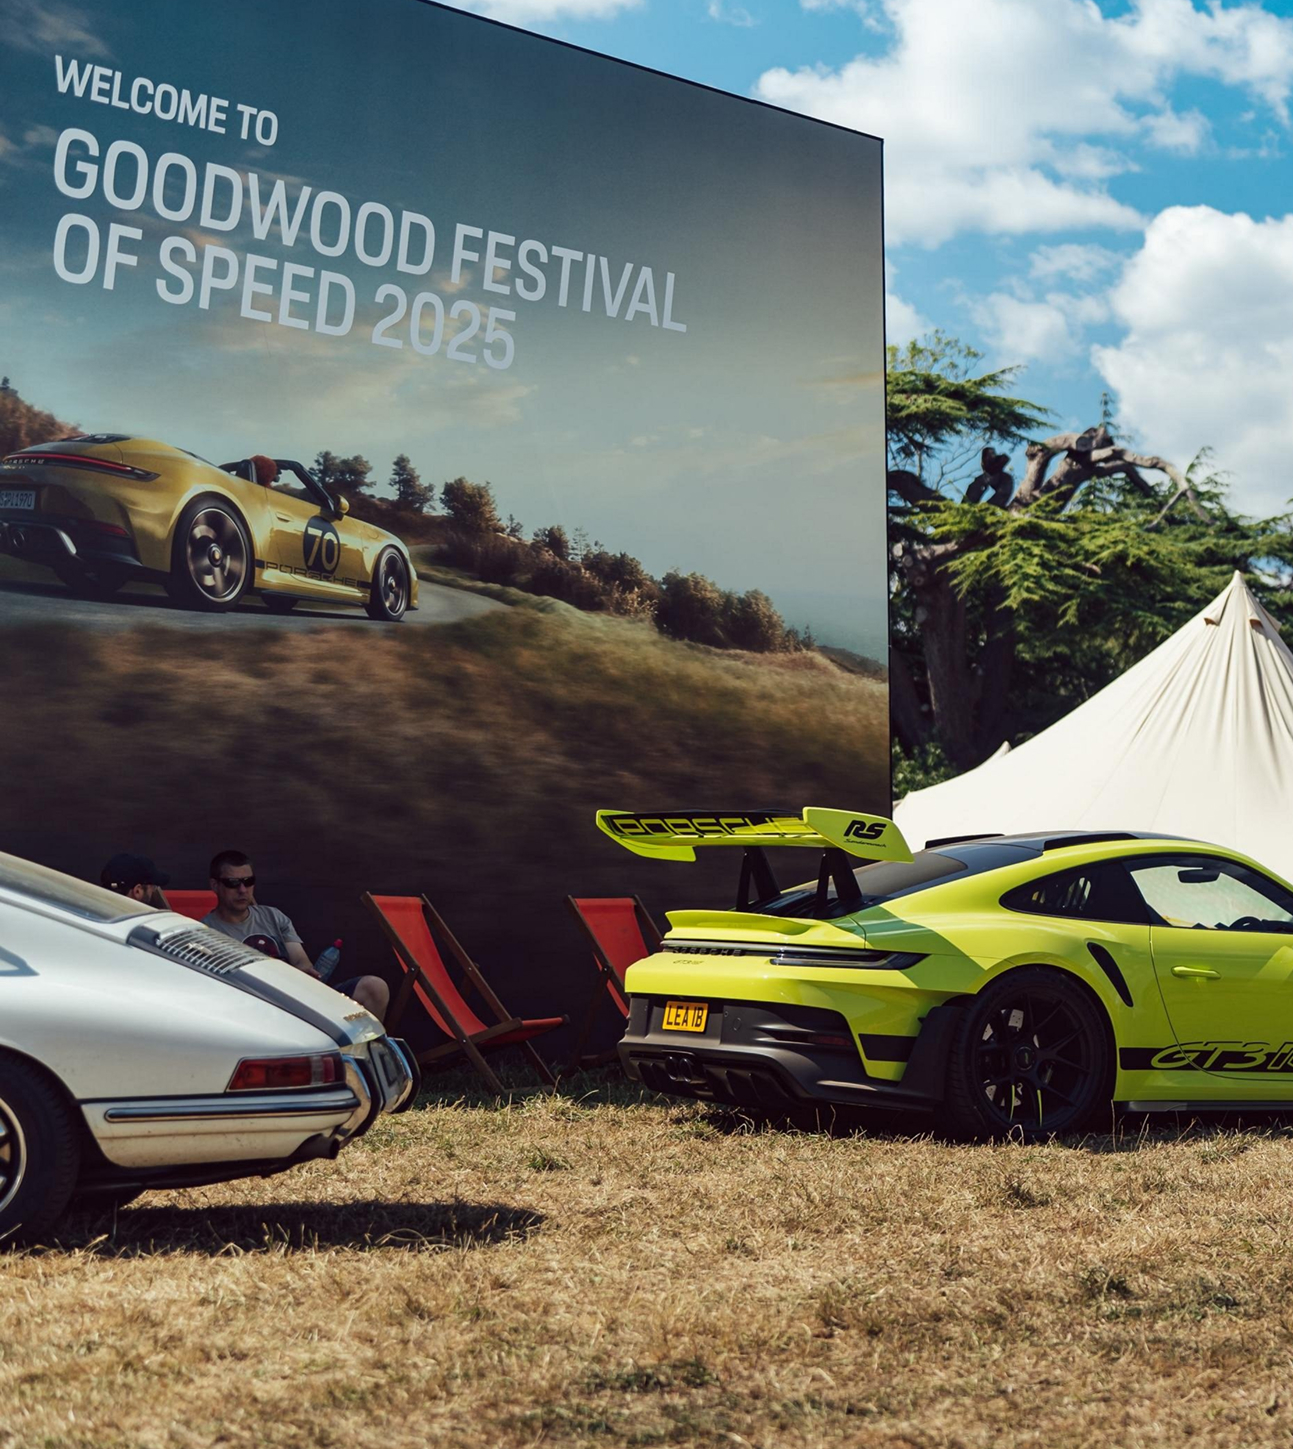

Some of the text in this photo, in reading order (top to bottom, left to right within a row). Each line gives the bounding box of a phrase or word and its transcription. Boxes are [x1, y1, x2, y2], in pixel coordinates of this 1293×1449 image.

[54, 55, 278, 146] WELCOME TO
[53, 128, 687, 333] GOODWOOD FESTIVAL
[53, 213, 517, 370] OF SPEED 2025
[307, 527, 338, 571] 70
[266, 561, 357, 587] PORSCHE
[843, 819, 888, 840] RS
[665, 1005, 690, 1027] LEA
